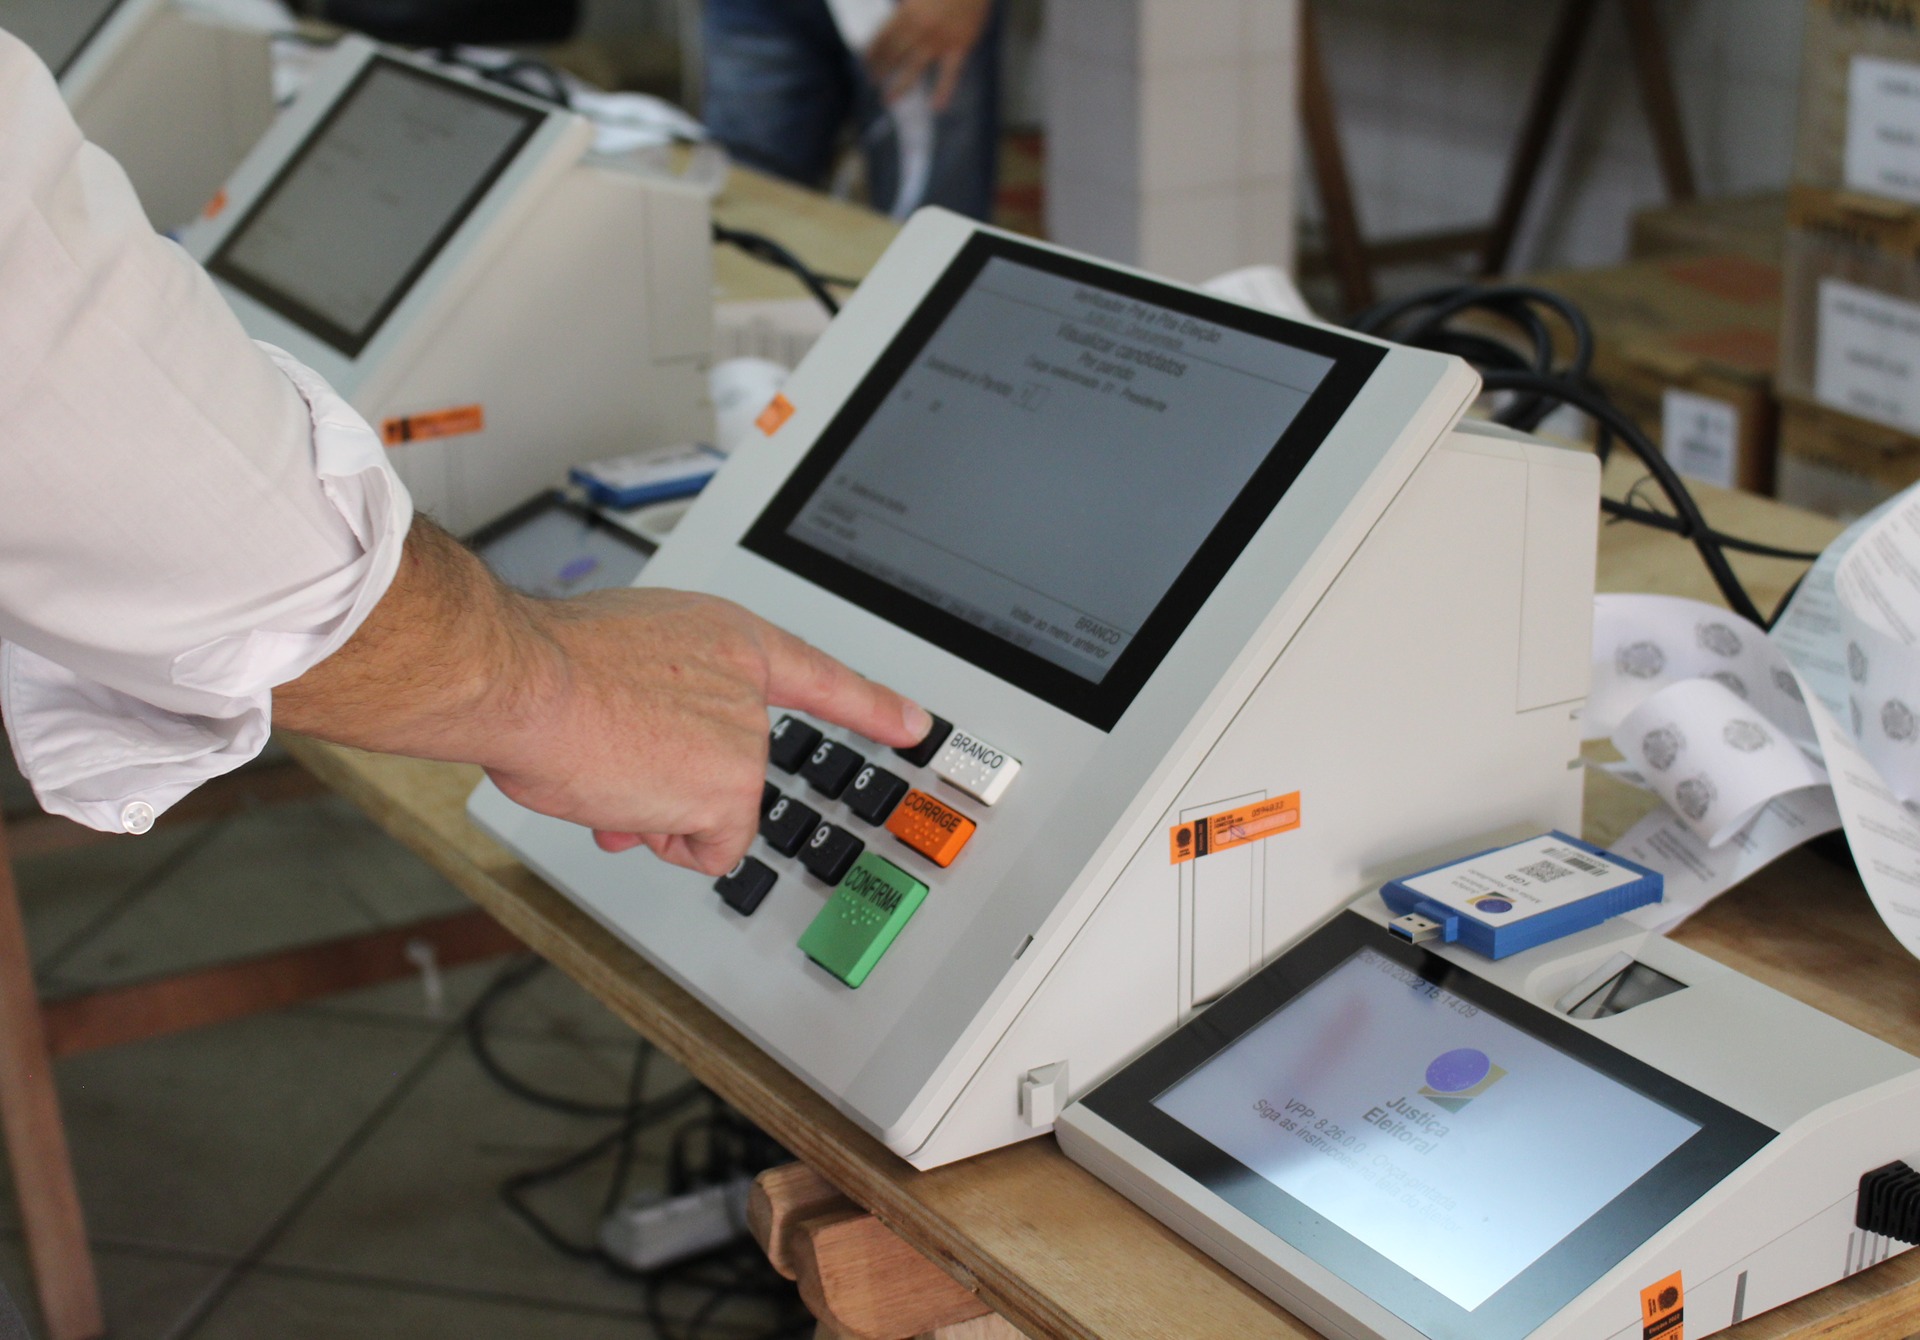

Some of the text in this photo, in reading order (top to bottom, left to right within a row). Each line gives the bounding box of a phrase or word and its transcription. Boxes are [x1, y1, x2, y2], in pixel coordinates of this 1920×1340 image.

[1034, 619, 1048, 631] ao
[1047, 625, 1073, 643] menu
[1072, 636, 1109, 660] anterior
[1075, 616, 1121, 646] BRANCO
[772, 719, 791, 739] 4
[812, 742, 833, 764] 5
[950, 733, 1003, 769] BRANCO
[854, 767, 874, 790] 6
[769, 799, 789, 821] 8
[904, 792, 962, 833] CORRIGE
[810, 826, 830, 847] 9
[844, 866, 903, 913] CONFIRMA
[1504, 874, 1531, 886] 1GB
[1284, 1098, 1318, 1124] VPP:
[1314, 1118, 1367, 1155] 8.26.0.0
[1362, 1107, 1438, 1156] Eleitoral
[1386, 1097, 1450, 1138] Justiça
[1252, 1099, 1280, 1123] Siga
[1279, 1117, 1298, 1132] as
[1361, 1164, 1376, 1182] na
[1376, 1176, 1402, 1198] tela
[1402, 1191, 1420, 1209] do
